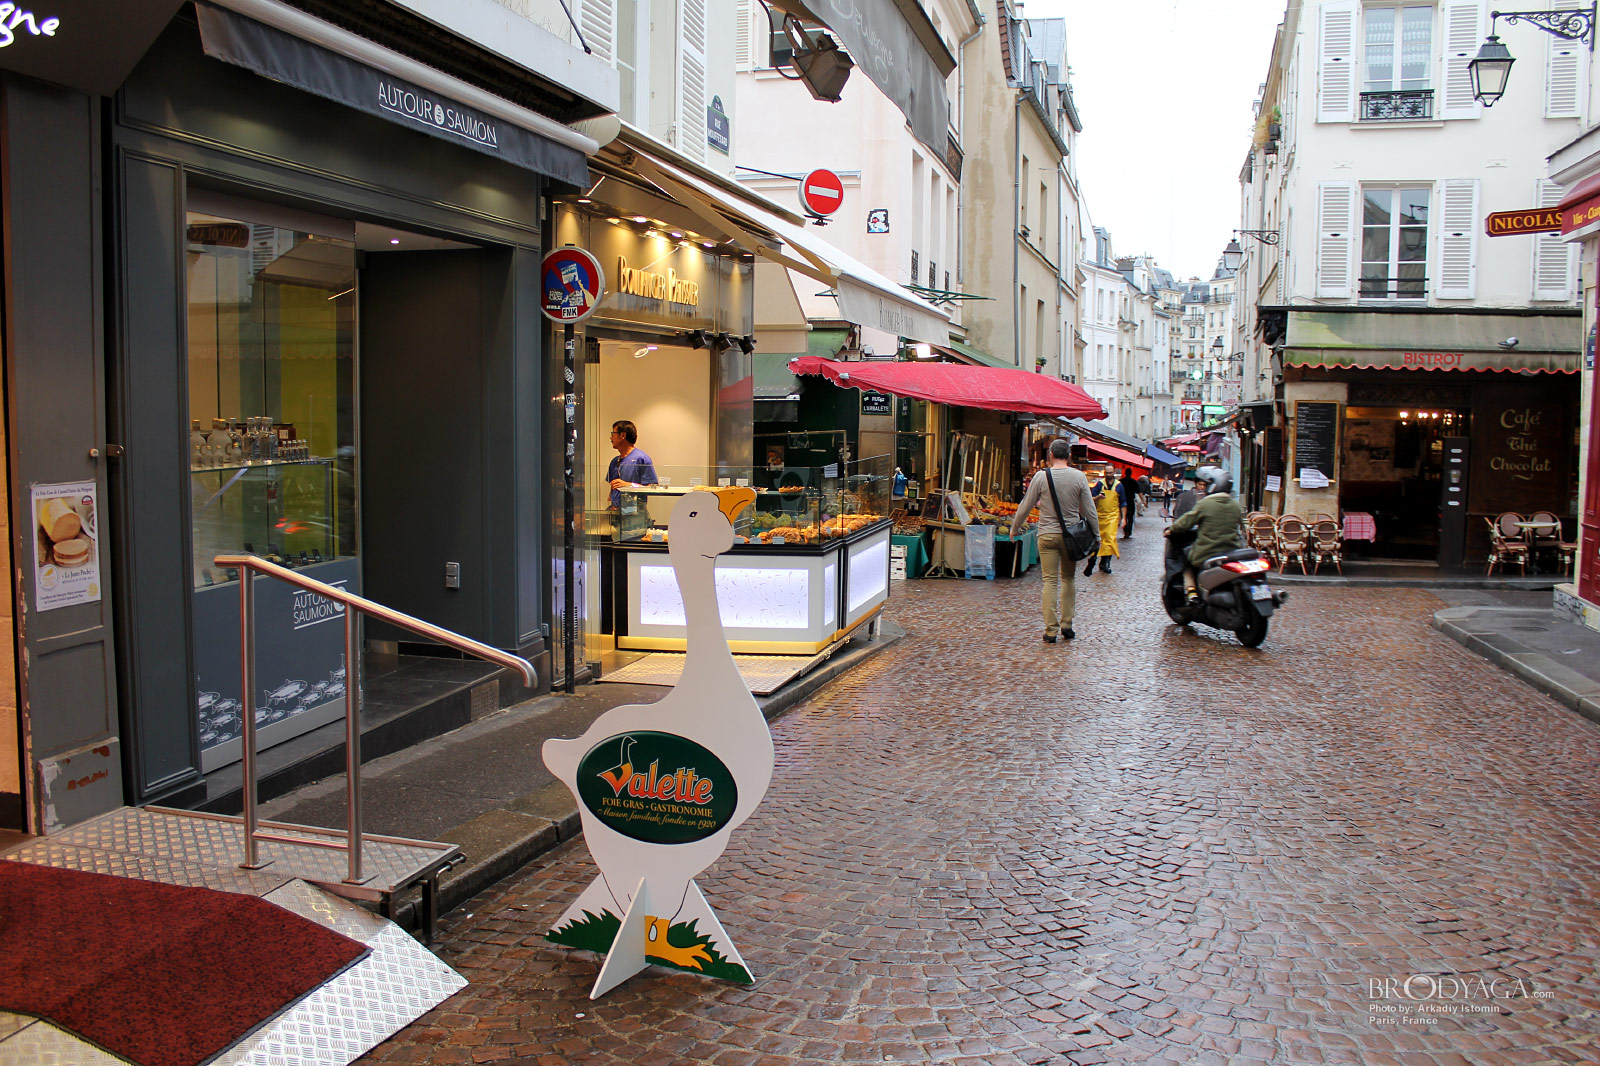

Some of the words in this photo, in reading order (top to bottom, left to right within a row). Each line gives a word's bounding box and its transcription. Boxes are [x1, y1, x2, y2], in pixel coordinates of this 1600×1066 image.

[378, 81, 433, 121] AUTOUR
[446, 108, 497, 144] SAUMON
[1494, 213, 1562, 230] NICOLAS
[618, 255, 666, 300] BOULANGER
[667, 267, 699, 306] PATISSIER
[562, 308, 577, 317] FNK
[1404, 352, 1465, 365] BISTROT
[1500, 408, 1543, 432] Café
[1506, 436, 1538, 451] Thé
[1490, 456, 1552, 472] Chocolat
[293, 593, 330, 610] AUTOU
[293, 602, 333, 624] SAUMON
[597, 758, 714, 805] Valette
[602, 797, 622, 807] FOIE
[622, 799, 644, 810] GRAS
[650, 802, 713, 818] GASTRONOMIE
[598, 807, 628, 818] Maison
[627, 811, 660, 822] familiale
[658, 815, 687, 826] fondée
[697, 818, 717, 830] 1920
